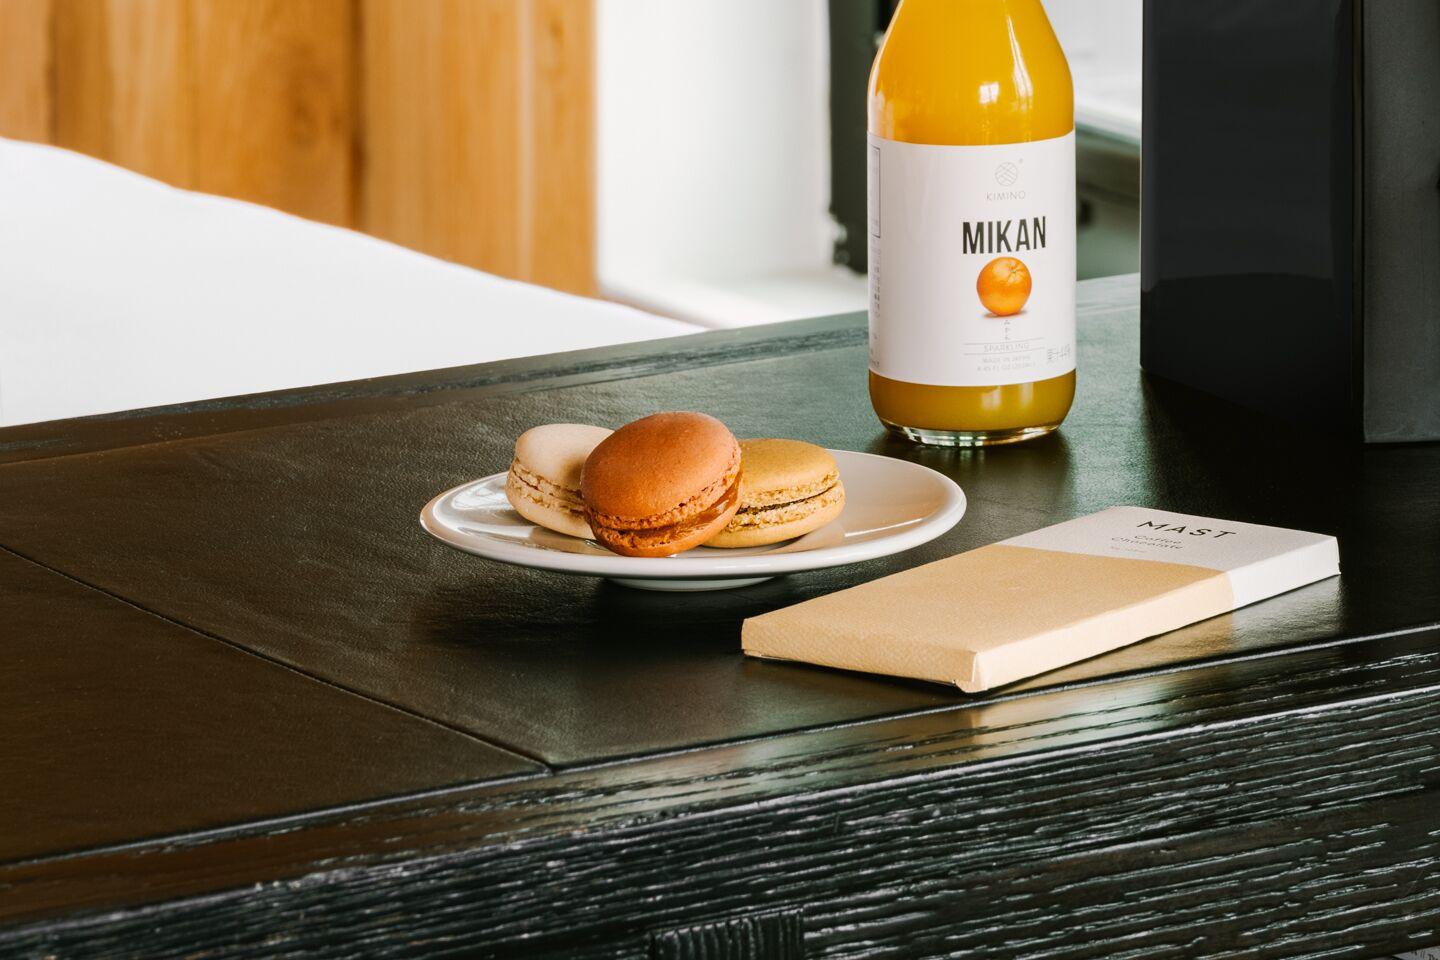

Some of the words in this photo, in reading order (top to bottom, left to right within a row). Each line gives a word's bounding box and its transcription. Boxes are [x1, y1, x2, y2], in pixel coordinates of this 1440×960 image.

[986, 190, 1026, 202] KIMINO
[962, 216, 1046, 255] MIKAN
[1136, 521, 1237, 539] MAST
